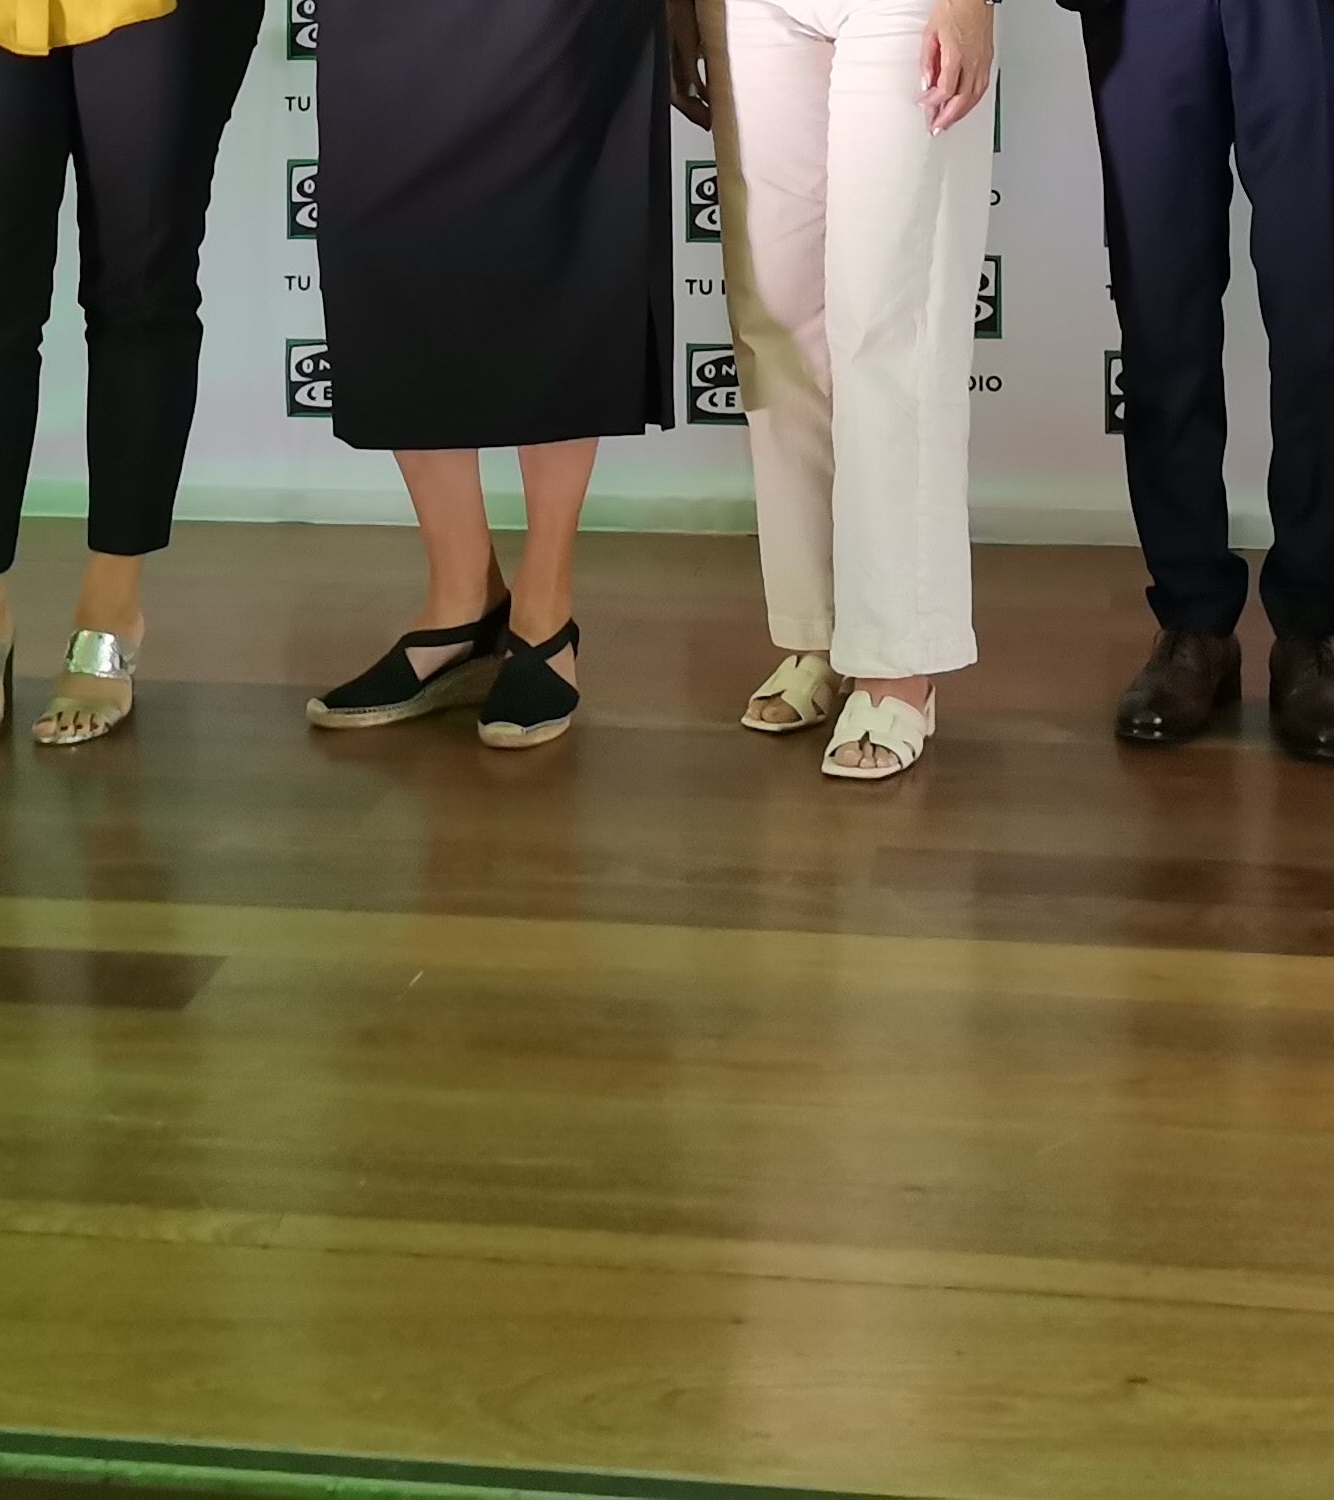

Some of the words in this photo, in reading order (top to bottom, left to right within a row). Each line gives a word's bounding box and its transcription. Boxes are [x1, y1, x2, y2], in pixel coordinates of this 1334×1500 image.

[284, 96, 311, 112] TU
[284, 275, 311, 291] TU
[685, 279, 712, 295] TU
[704, 363, 736, 379] ON
[708, 391, 736, 408] CE
